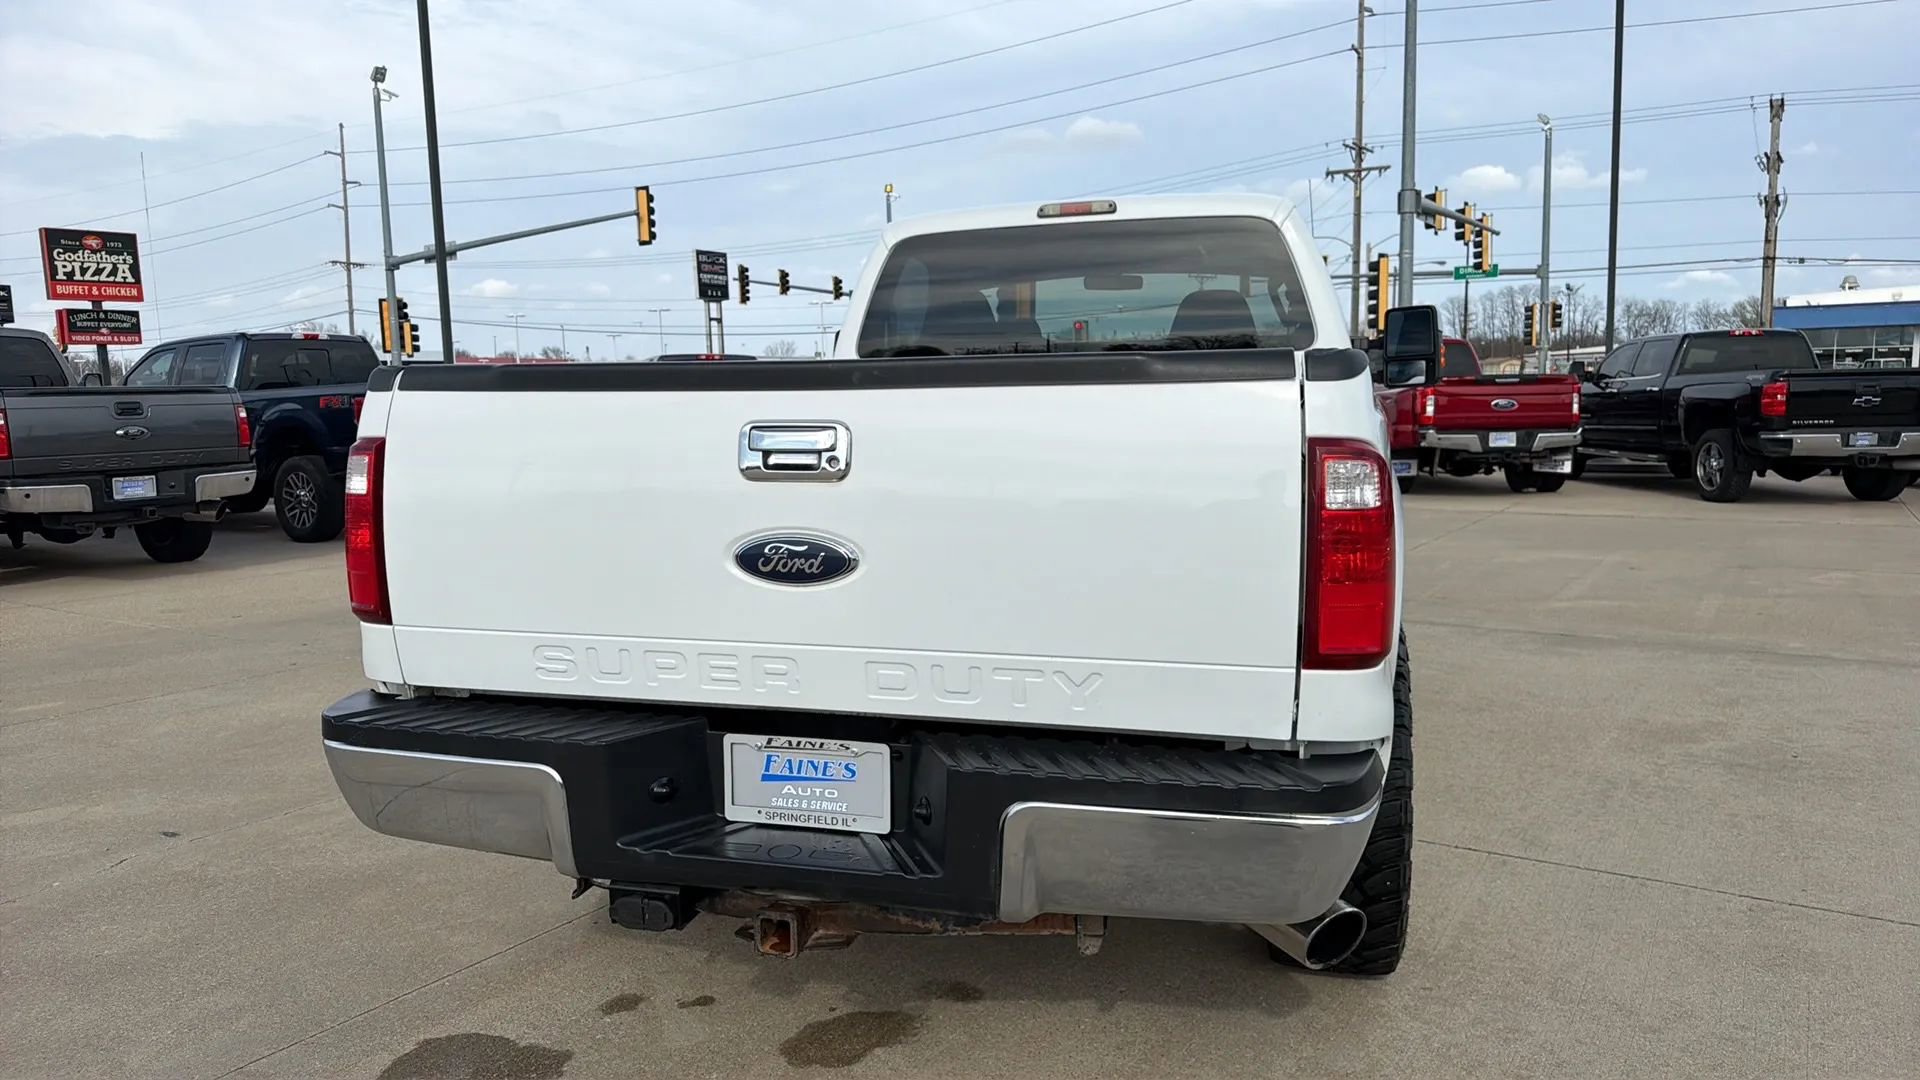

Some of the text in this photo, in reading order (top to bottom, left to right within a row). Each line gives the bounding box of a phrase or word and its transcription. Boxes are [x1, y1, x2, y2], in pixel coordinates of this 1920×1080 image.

[53, 248, 134, 265] Godfather's
[699, 254, 726, 264] BUICK
[54, 261, 135, 282] PIZZA
[56, 284, 138, 297] BUFFET & CHICKEN
[70, 311, 137, 324] LUNCH & DINNER
[757, 543, 826, 574] Ford
[533, 645, 1104, 711] SUPER DUTY
[764, 737, 852, 751] FAINE'S
[763, 753, 857, 780] FAINE'S
[781, 784, 839, 798] AUTO
[771, 797, 849, 812] SALES & SERVICE
[764, 811, 851, 827] SPRINGFIELD IL
